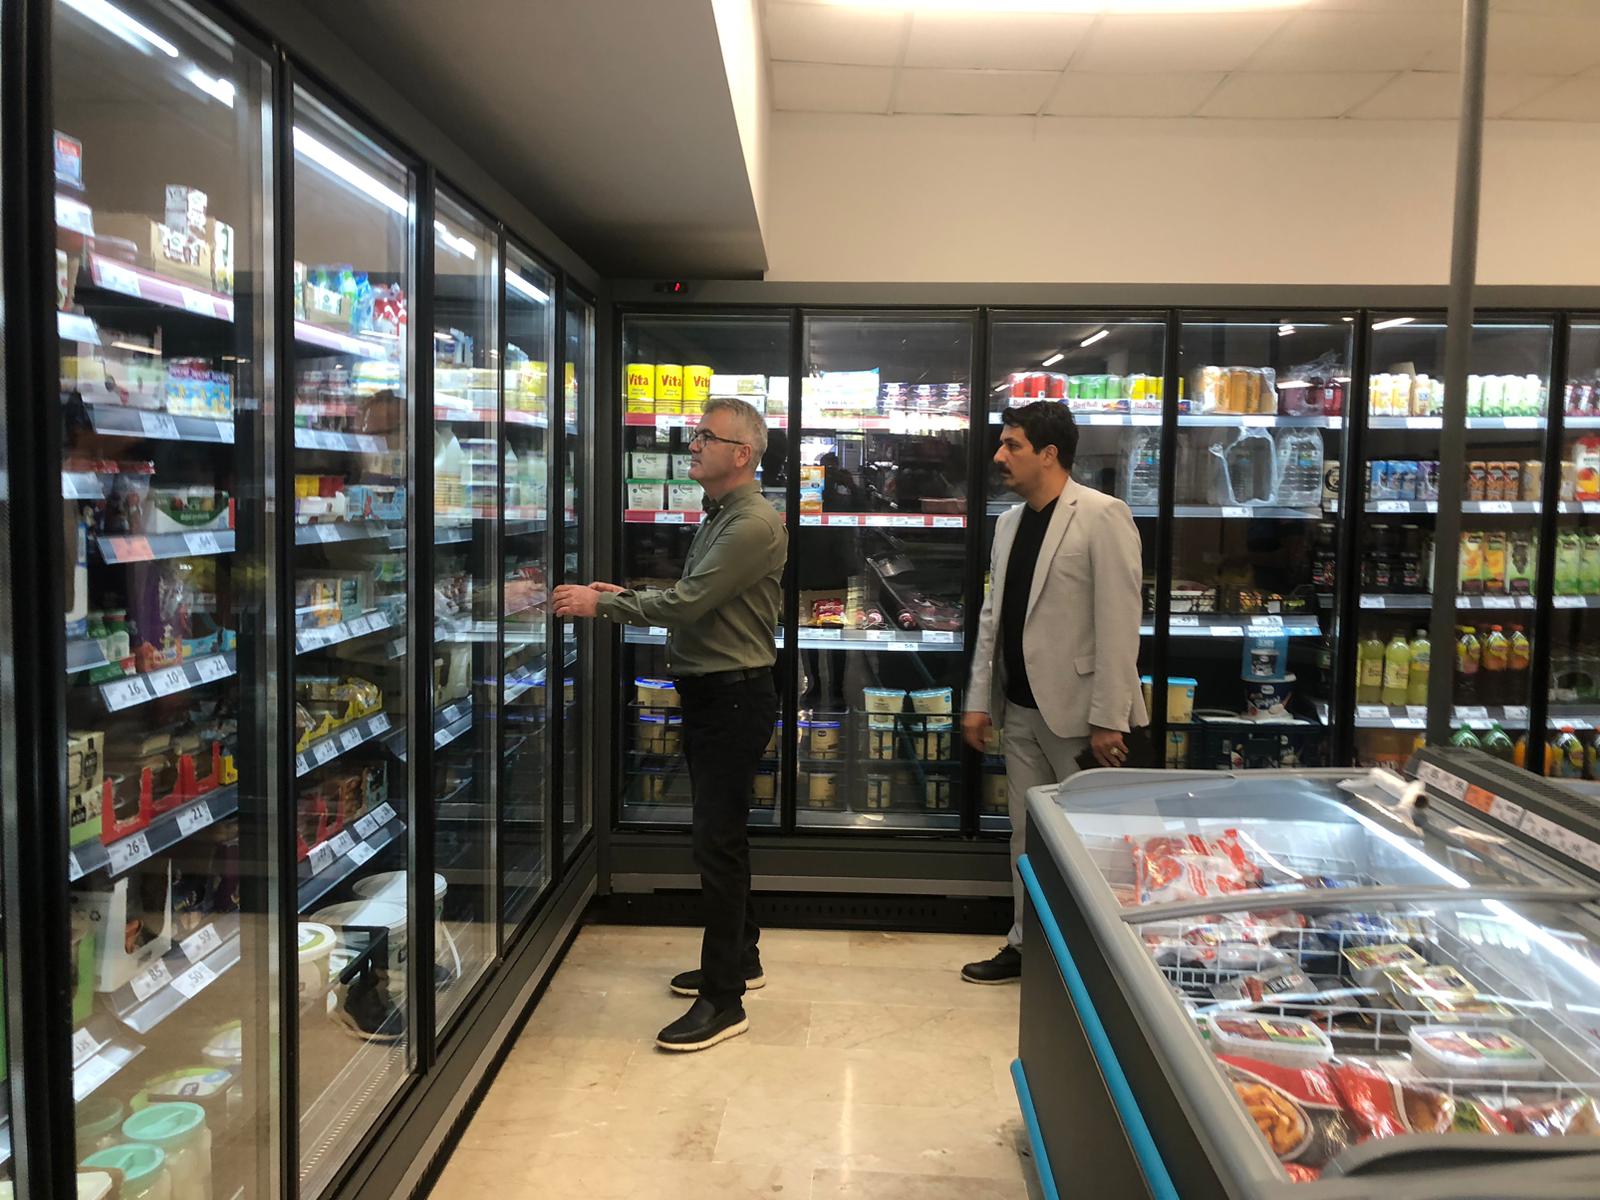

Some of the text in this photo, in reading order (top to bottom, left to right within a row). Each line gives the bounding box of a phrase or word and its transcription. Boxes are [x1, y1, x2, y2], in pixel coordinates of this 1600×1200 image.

[629, 374, 649, 386] Vita
[661, 375, 682, 387] Vita
[166, 671, 179, 684] 10
[128, 683, 140, 696] 16
[127, 840, 140, 856] 26
